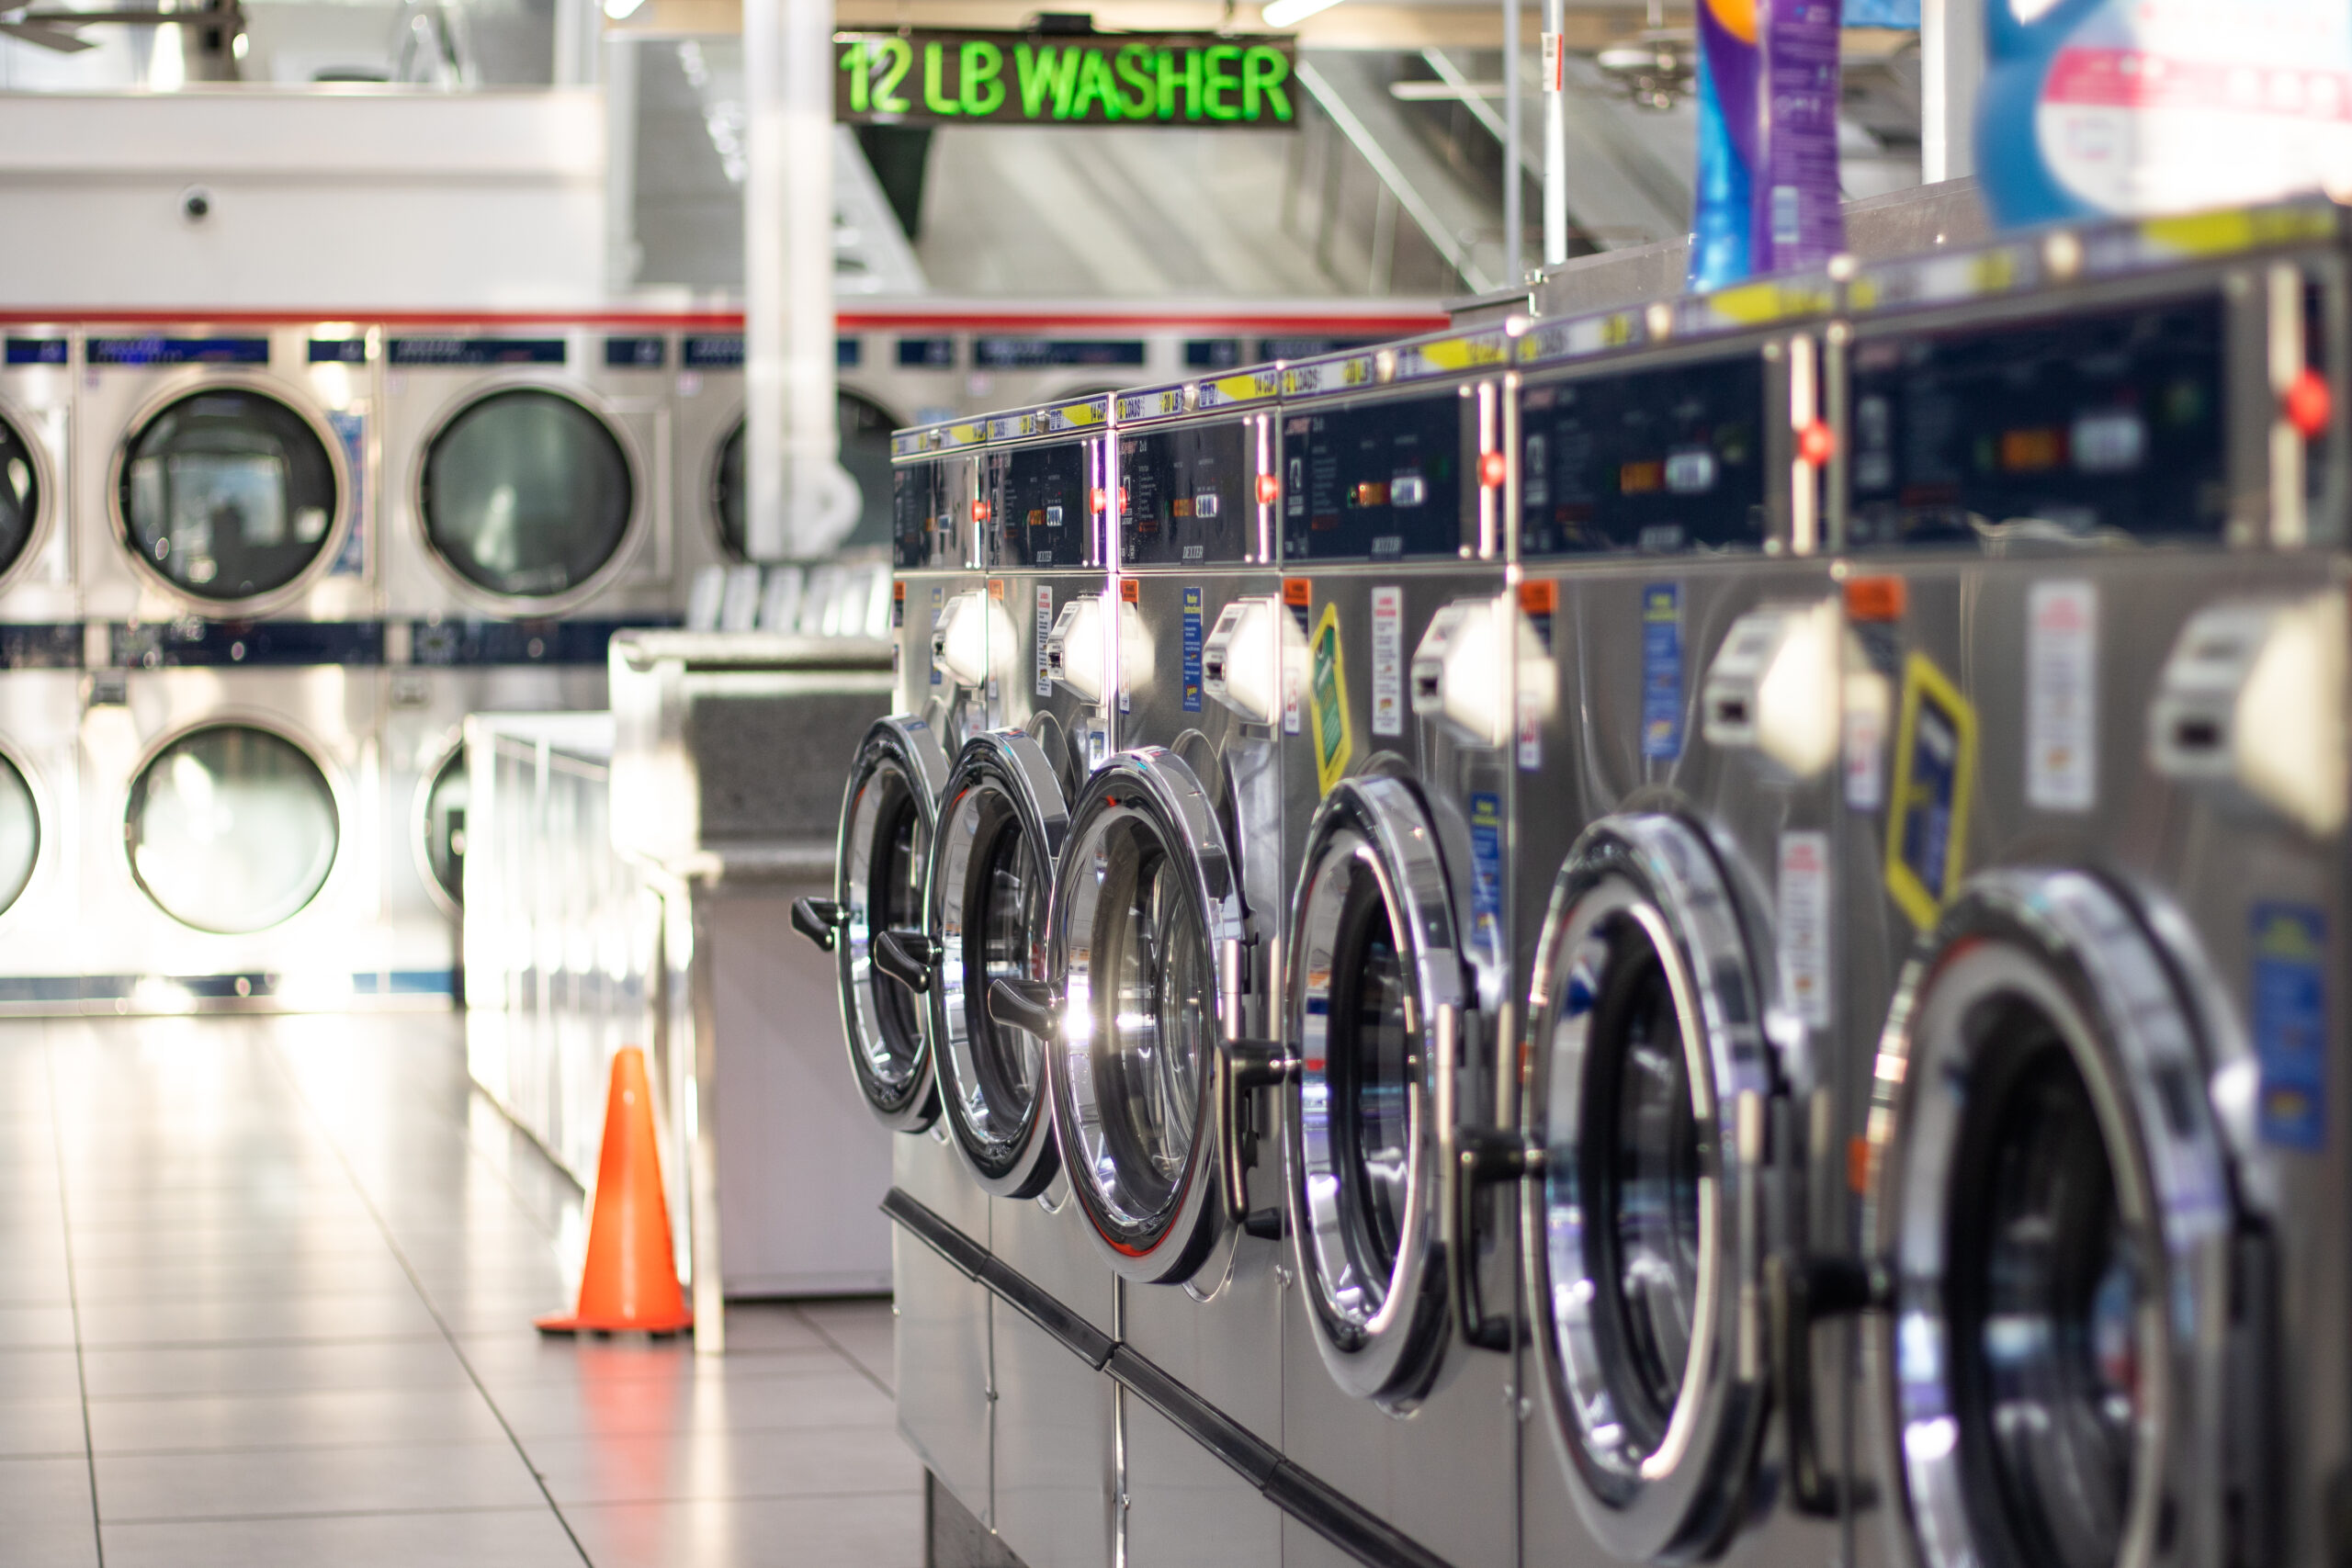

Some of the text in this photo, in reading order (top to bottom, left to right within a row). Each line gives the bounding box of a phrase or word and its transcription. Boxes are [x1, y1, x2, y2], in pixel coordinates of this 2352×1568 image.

[841, 39, 1293, 122] 12 LB WASHER
[1125, 398, 1141, 419] LOADS
[1182, 545, 1204, 559] DEXTER
